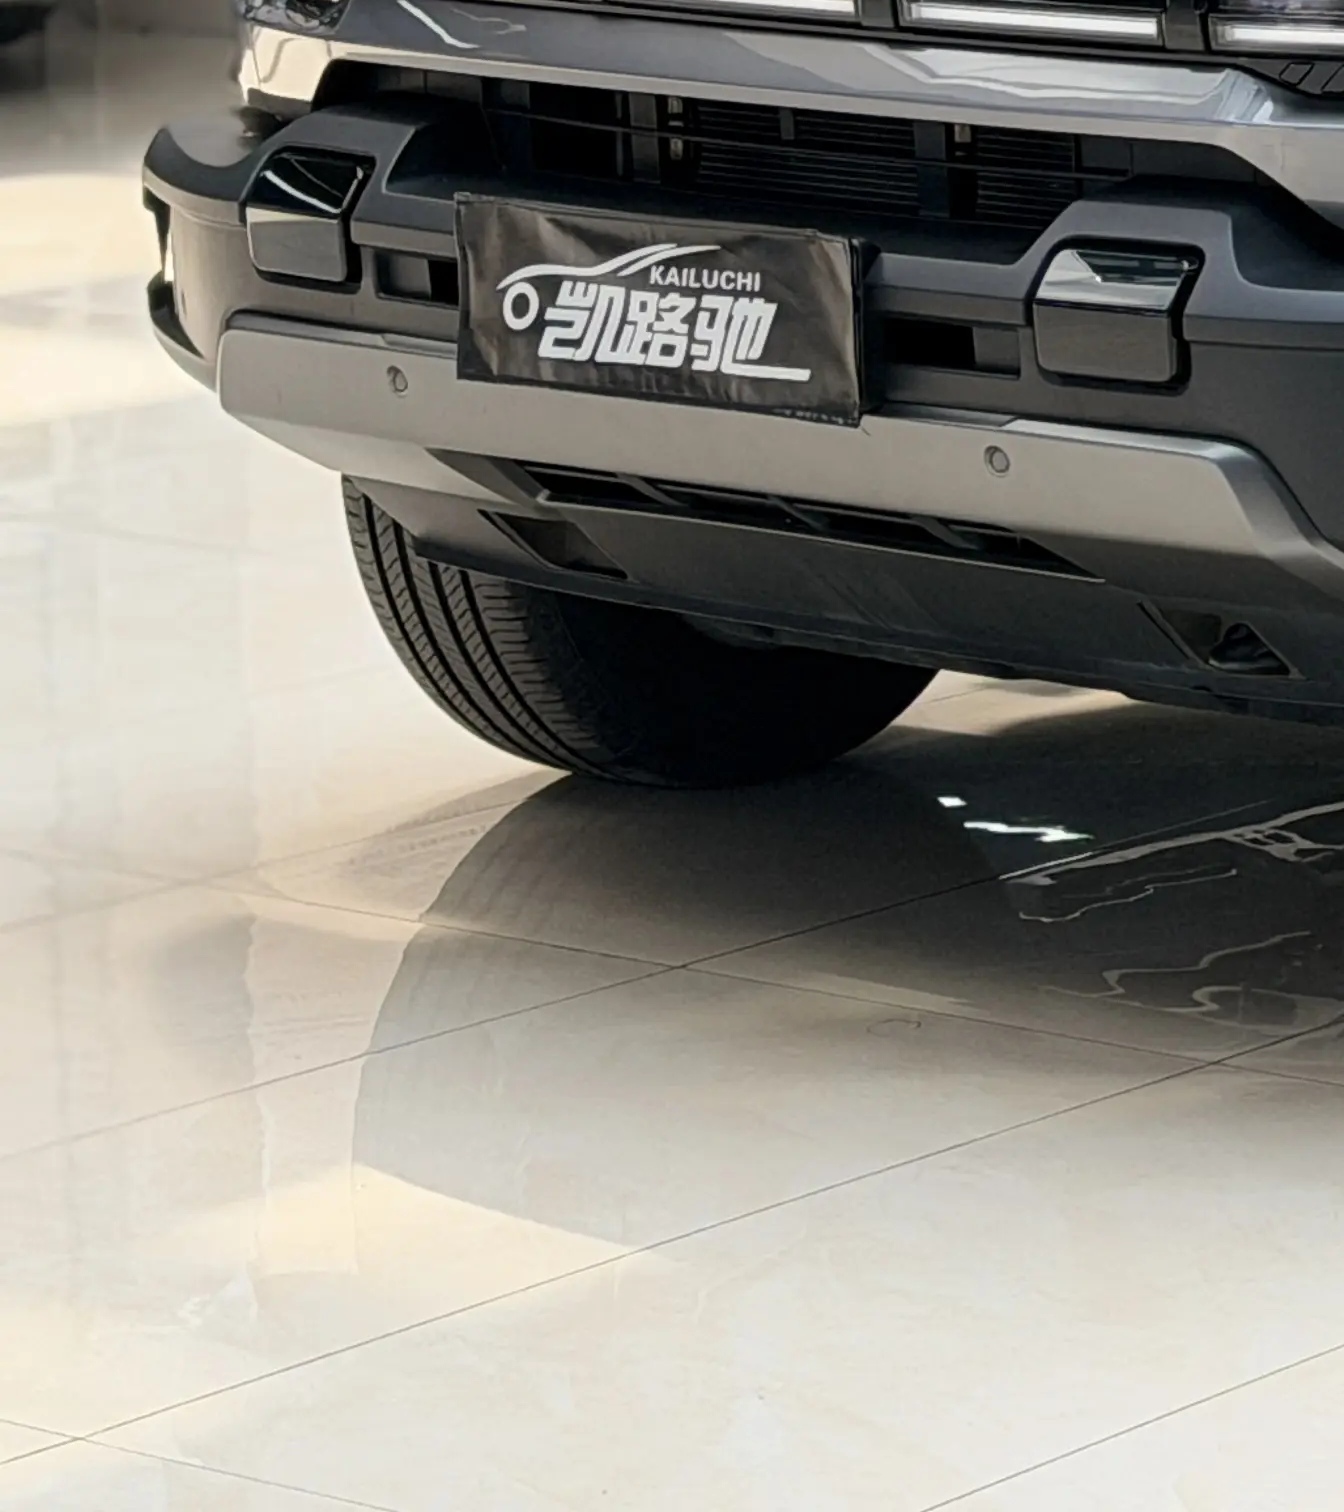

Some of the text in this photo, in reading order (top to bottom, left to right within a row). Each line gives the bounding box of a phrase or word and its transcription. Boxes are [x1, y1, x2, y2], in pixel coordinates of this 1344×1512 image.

[648, 264, 761, 292] KAILUCHI
[537, 279, 812, 383] 凯路驰
